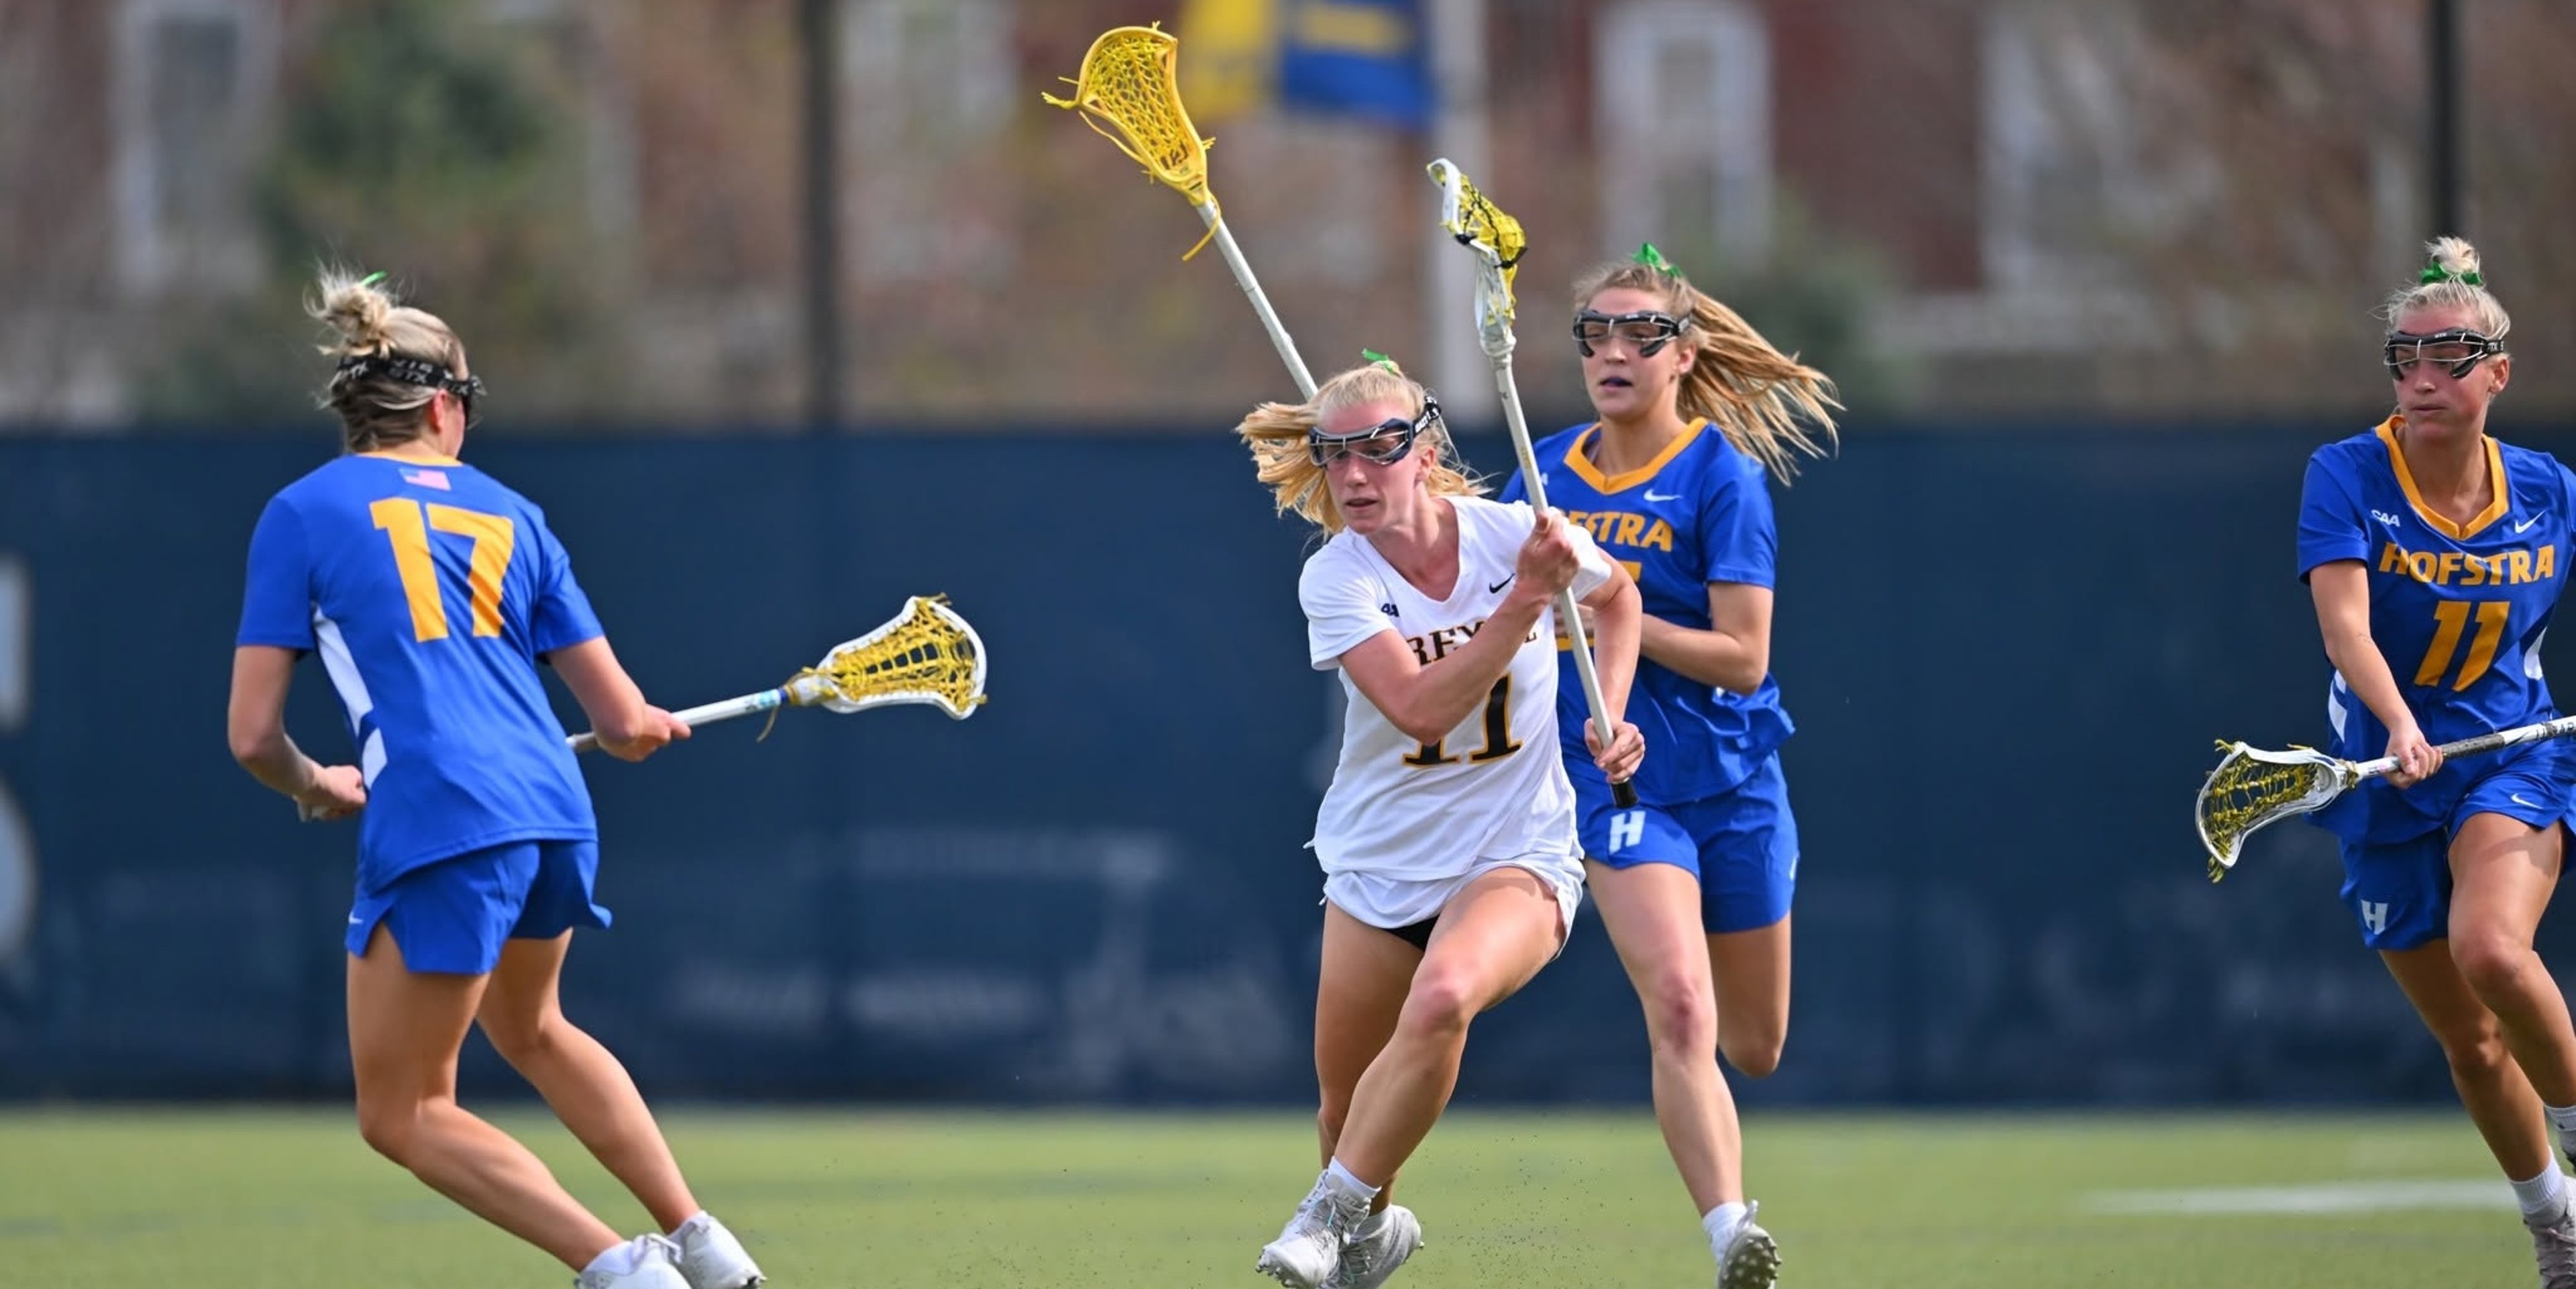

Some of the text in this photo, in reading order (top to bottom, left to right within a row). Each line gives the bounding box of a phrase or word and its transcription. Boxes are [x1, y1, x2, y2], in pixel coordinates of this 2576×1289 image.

[1562, 510, 1673, 552] FSTRA
[2371, 509, 2400, 527] CAA
[370, 497, 514, 642] 17
[2379, 542, 2555, 586] HOFSTRA
[2414, 600, 2511, 692] 11
[1609, 811, 1646, 852] H
[2361, 899, 2388, 935] H
